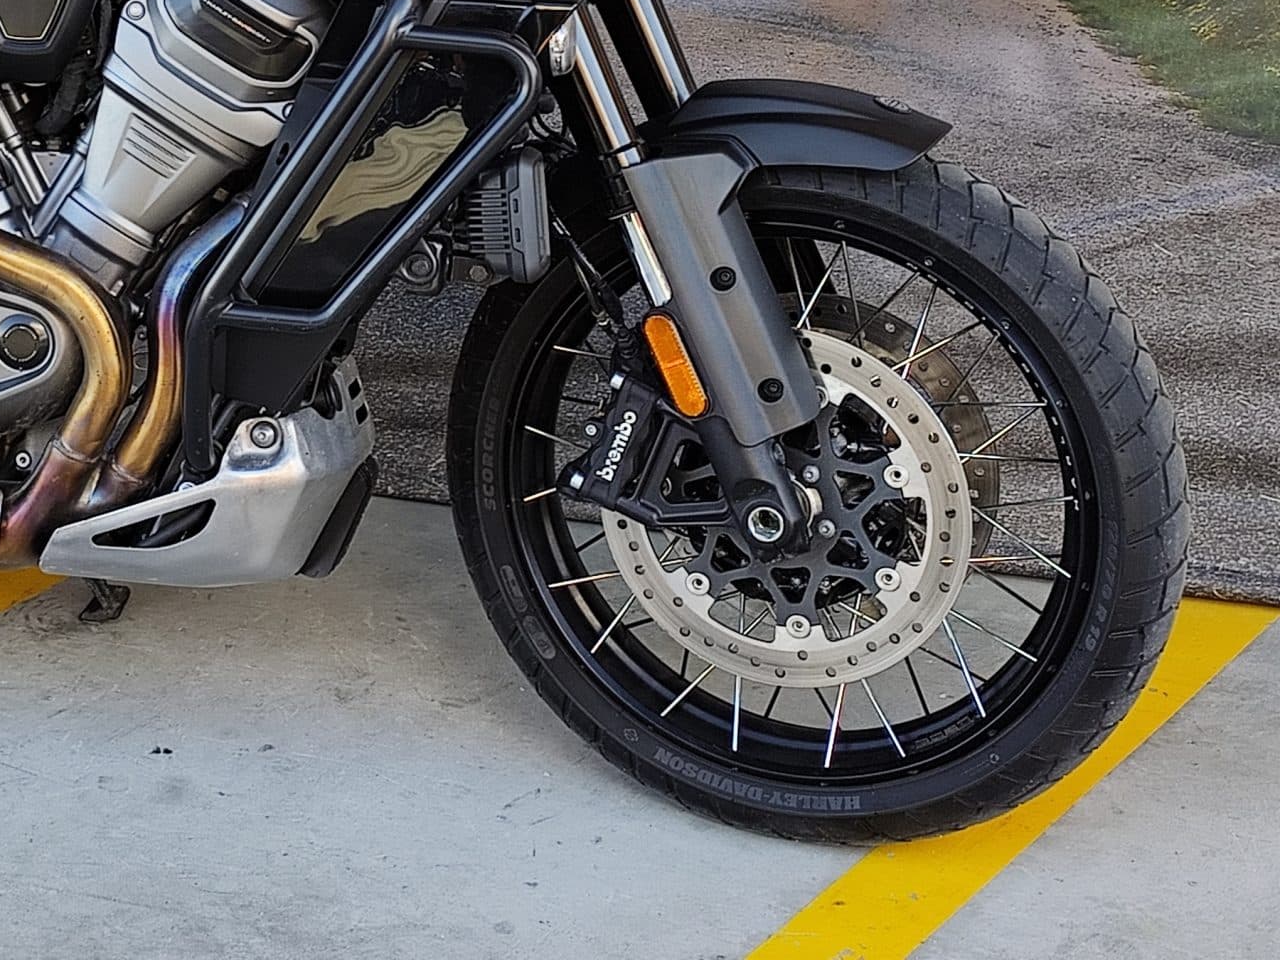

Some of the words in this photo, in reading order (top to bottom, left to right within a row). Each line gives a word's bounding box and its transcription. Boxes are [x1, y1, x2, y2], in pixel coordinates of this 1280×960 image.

[481, 398, 500, 512] SCORCHER
[596, 411, 637, 482] brembo
[652, 746, 861, 811] HARLEY-DAVIDSON
